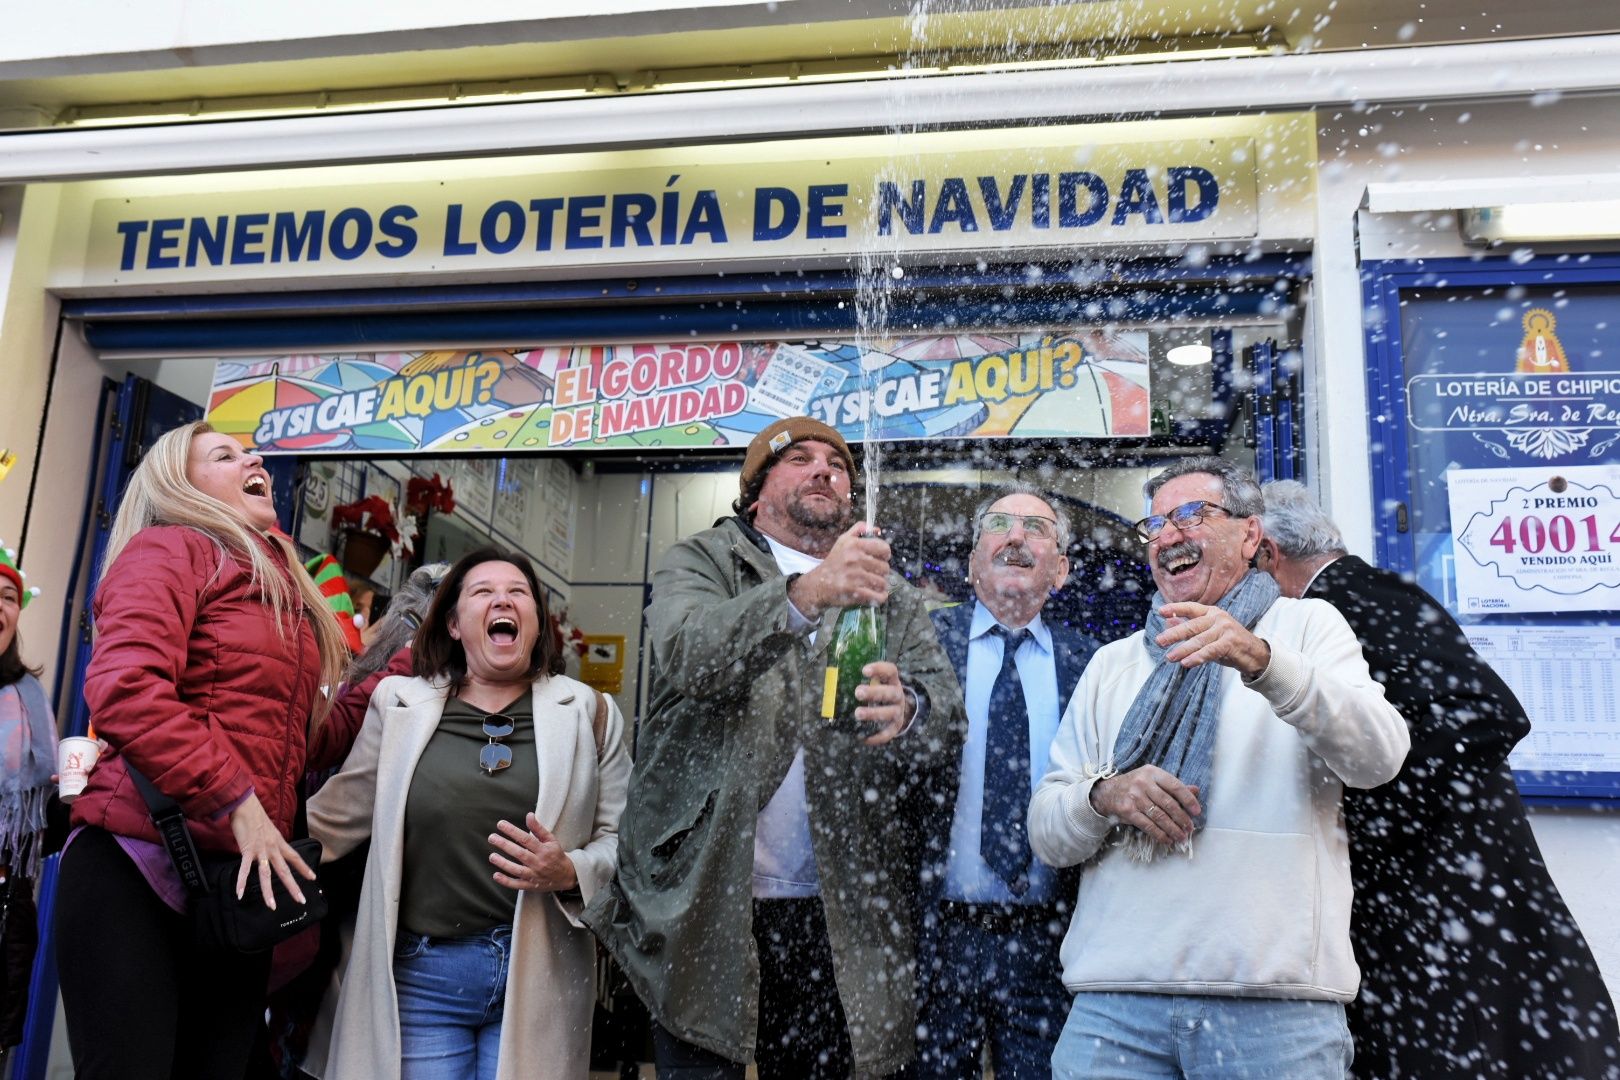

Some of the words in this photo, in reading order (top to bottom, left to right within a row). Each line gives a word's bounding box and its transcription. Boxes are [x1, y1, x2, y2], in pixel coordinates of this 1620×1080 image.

[117, 205, 418, 271] TENEMOS
[443, 174, 728, 257] LOTERÍA
[753, 183, 849, 242] DE
[878, 166, 1220, 236] NAVIDAD
[316, 389, 378, 432] CAE
[375, 354, 502, 421] AQUÍ?
[554, 367, 596, 407] EL
[601, 342, 742, 398] GORDO
[875, 373, 941, 417] CAE
[943, 336, 1082, 405] AQUÍ?
[1436, 378, 1520, 397] LOTERÍA
[1525, 380, 1551, 395] DE
[550, 409, 592, 444] DE
[599, 382, 746, 436] NAVIDAD
[1447, 405, 1501, 426] Ntra.
[1504, 404, 1554, 425] Sra.
[1561, 405, 1581, 422] de
[1534, 496, 1598, 509] PREMIO
[1520, 556, 1577, 566] VENDIDO
[1580, 552, 1613, 566] AQUÍ
